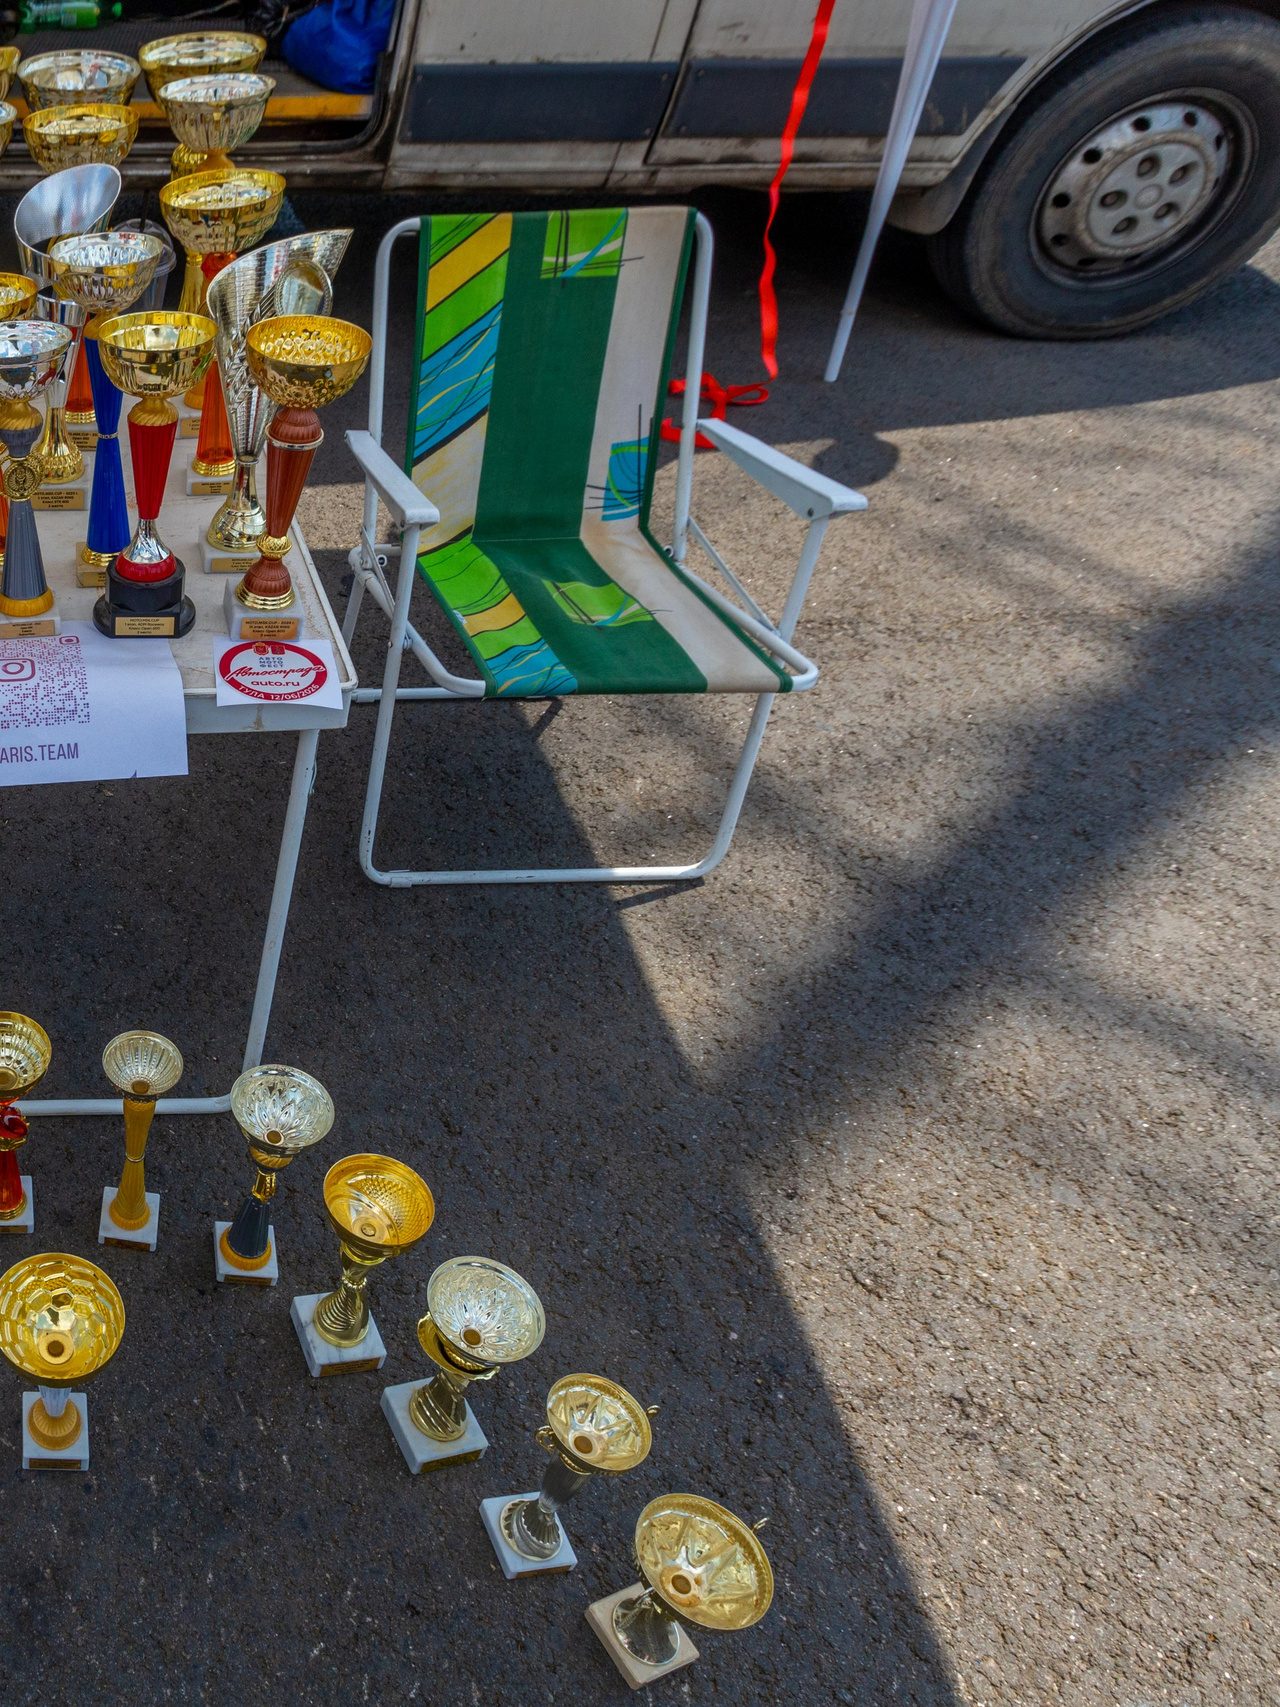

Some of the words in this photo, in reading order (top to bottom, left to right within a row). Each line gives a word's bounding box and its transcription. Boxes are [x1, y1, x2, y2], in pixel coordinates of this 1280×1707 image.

[224, 665, 327, 680] Автострада
[238, 685, 265, 699] ТУЛА
[270, 683, 320, 700] 12/06/2026
